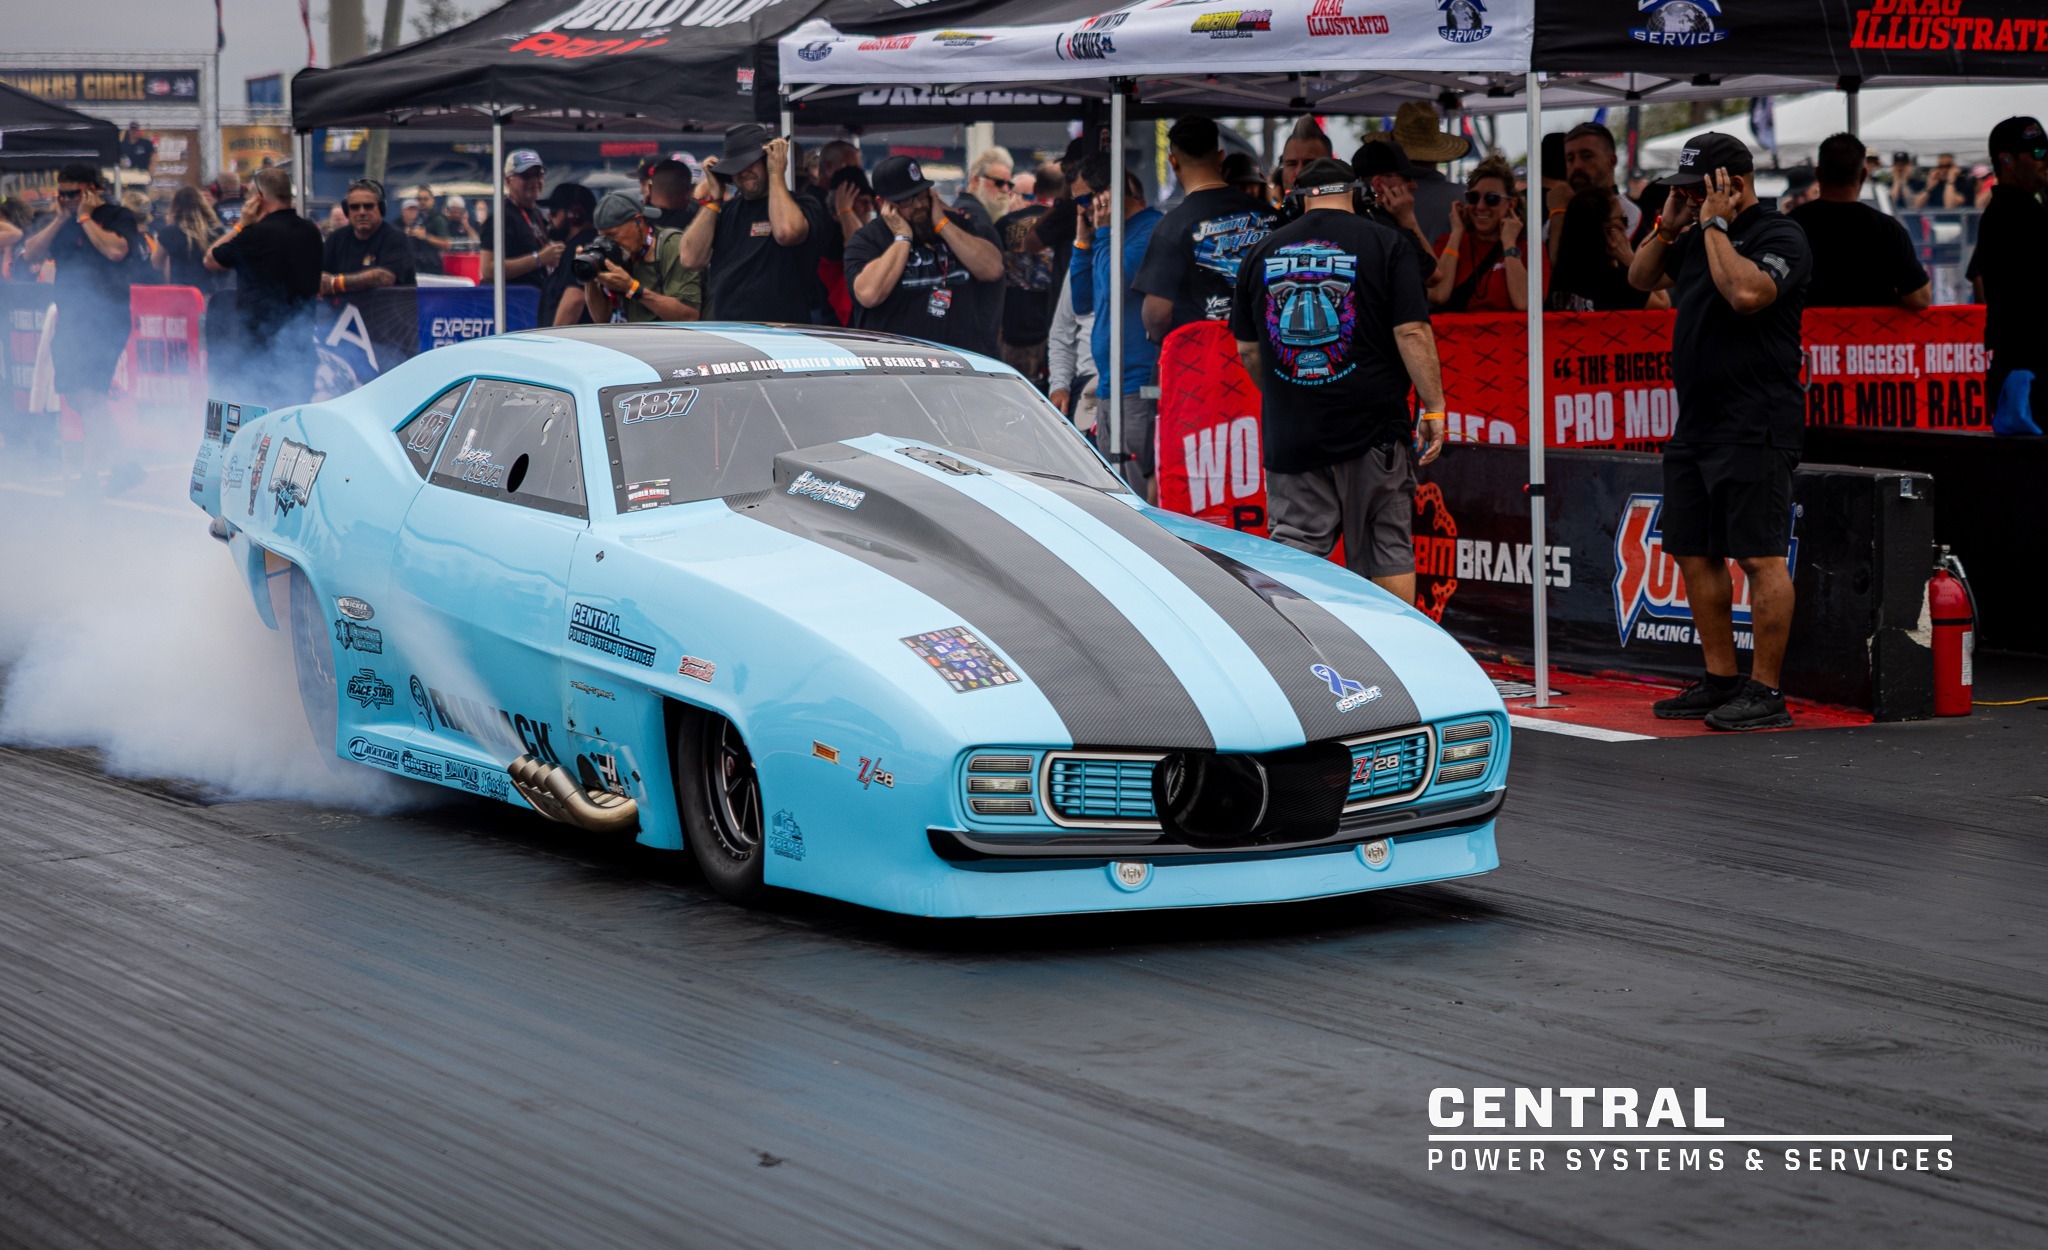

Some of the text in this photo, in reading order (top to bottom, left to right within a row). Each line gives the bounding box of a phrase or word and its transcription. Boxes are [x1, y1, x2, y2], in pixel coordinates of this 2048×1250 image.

[1307, 15, 1389, 36] ILLUSTRATED
[1439, 27, 1492, 43] SERVICE
[1631, 30, 1727, 46] SERVICE
[82, 72, 146, 100] CIRCLE
[1193, 215, 1250, 242] Jimmy
[1264, 256, 1357, 280] BLUE
[431, 318, 493, 338] EXPERT
[712, 356, 926, 376] DRAG ILLUSTRATED WINTER SERIES
[1808, 344, 1841, 375] THE
[1846, 343, 1920, 379] BIGGEST,
[619, 387, 700, 425] 187
[1855, 380, 1917, 428] MOD
[1554, 391, 1614, 445] PRO
[406, 410, 453, 454] 187
[1411, 535, 1456, 577] BM
[571, 602, 620, 636] CENTRAL
[1636, 622, 1690, 643] RACING
[568, 628, 589, 645] POWER
[589, 634, 617, 657] SYSTEMS
[623, 647, 655, 667] SERVICES
[348, 684, 393, 699] RACE STAR
[1336, 685, 1382, 713] #STOUT
[364, 744, 398, 762] MAXIMA
[403, 755, 442, 775] KINETIC
[1352, 749, 1400, 783] Z/28
[445, 760, 479, 784] DIAMOND
[857, 756, 894, 790] Z/28
